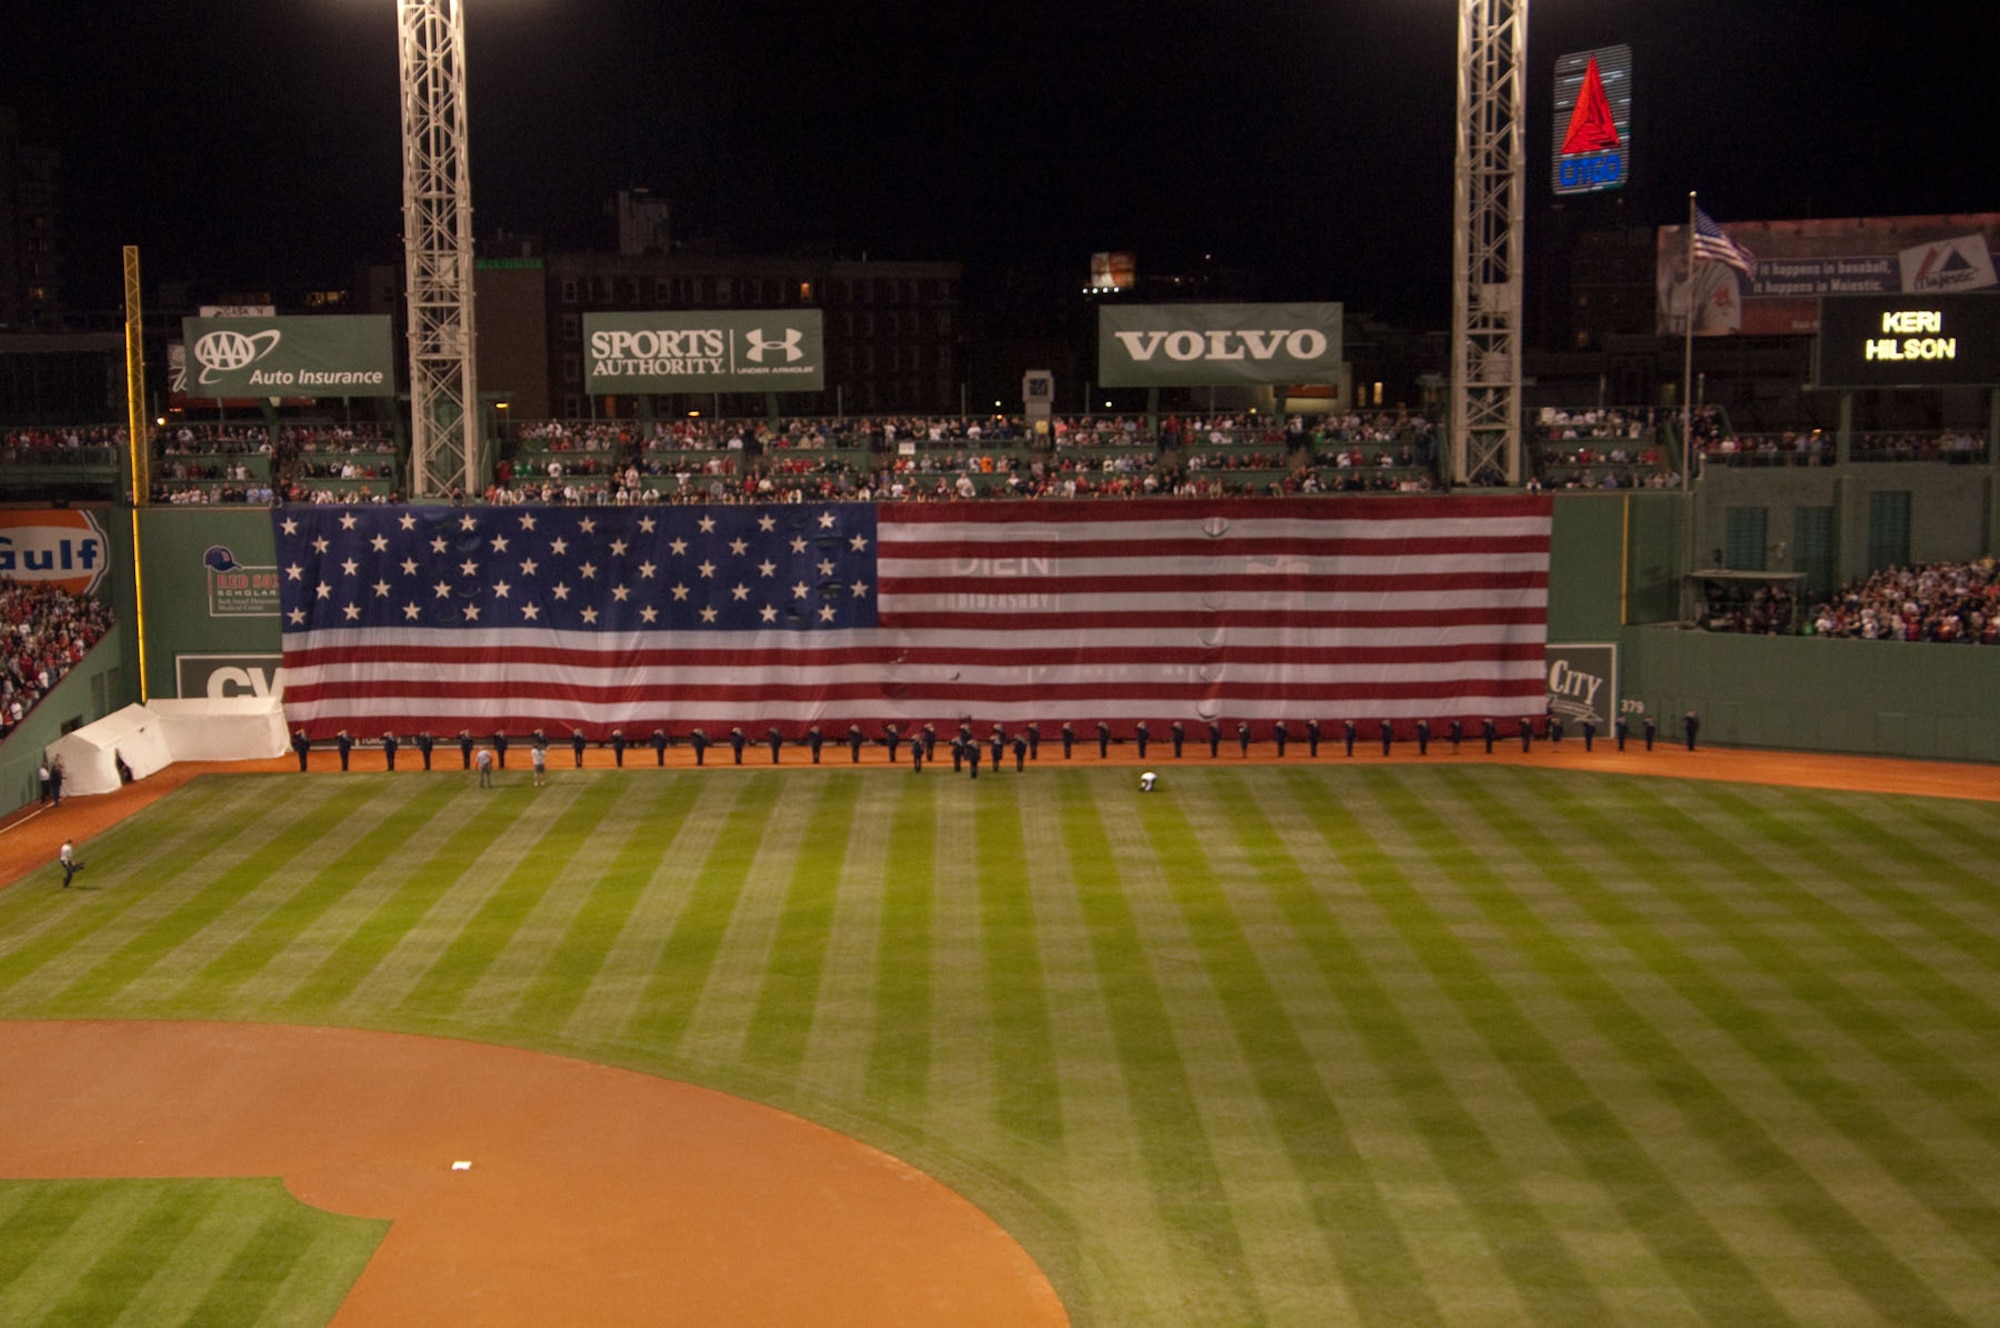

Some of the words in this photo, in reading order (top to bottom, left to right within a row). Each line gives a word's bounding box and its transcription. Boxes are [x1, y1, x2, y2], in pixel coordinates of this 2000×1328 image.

[1560, 154, 1621, 186] CITGO
[1882, 311, 1941, 333] KERI
[201, 332, 249, 369] AAA
[591, 329, 724, 359] SPORTS
[1114, 329, 1327, 361] VOLVO
[1866, 337, 1956, 361] HILSON
[249, 369, 294, 385] Auto
[298, 369, 383, 385] Insurance
[592, 358, 724, 376] AUTHORITY
[217, 574, 248, 589] RED
[1621, 699, 1645, 714] 379
